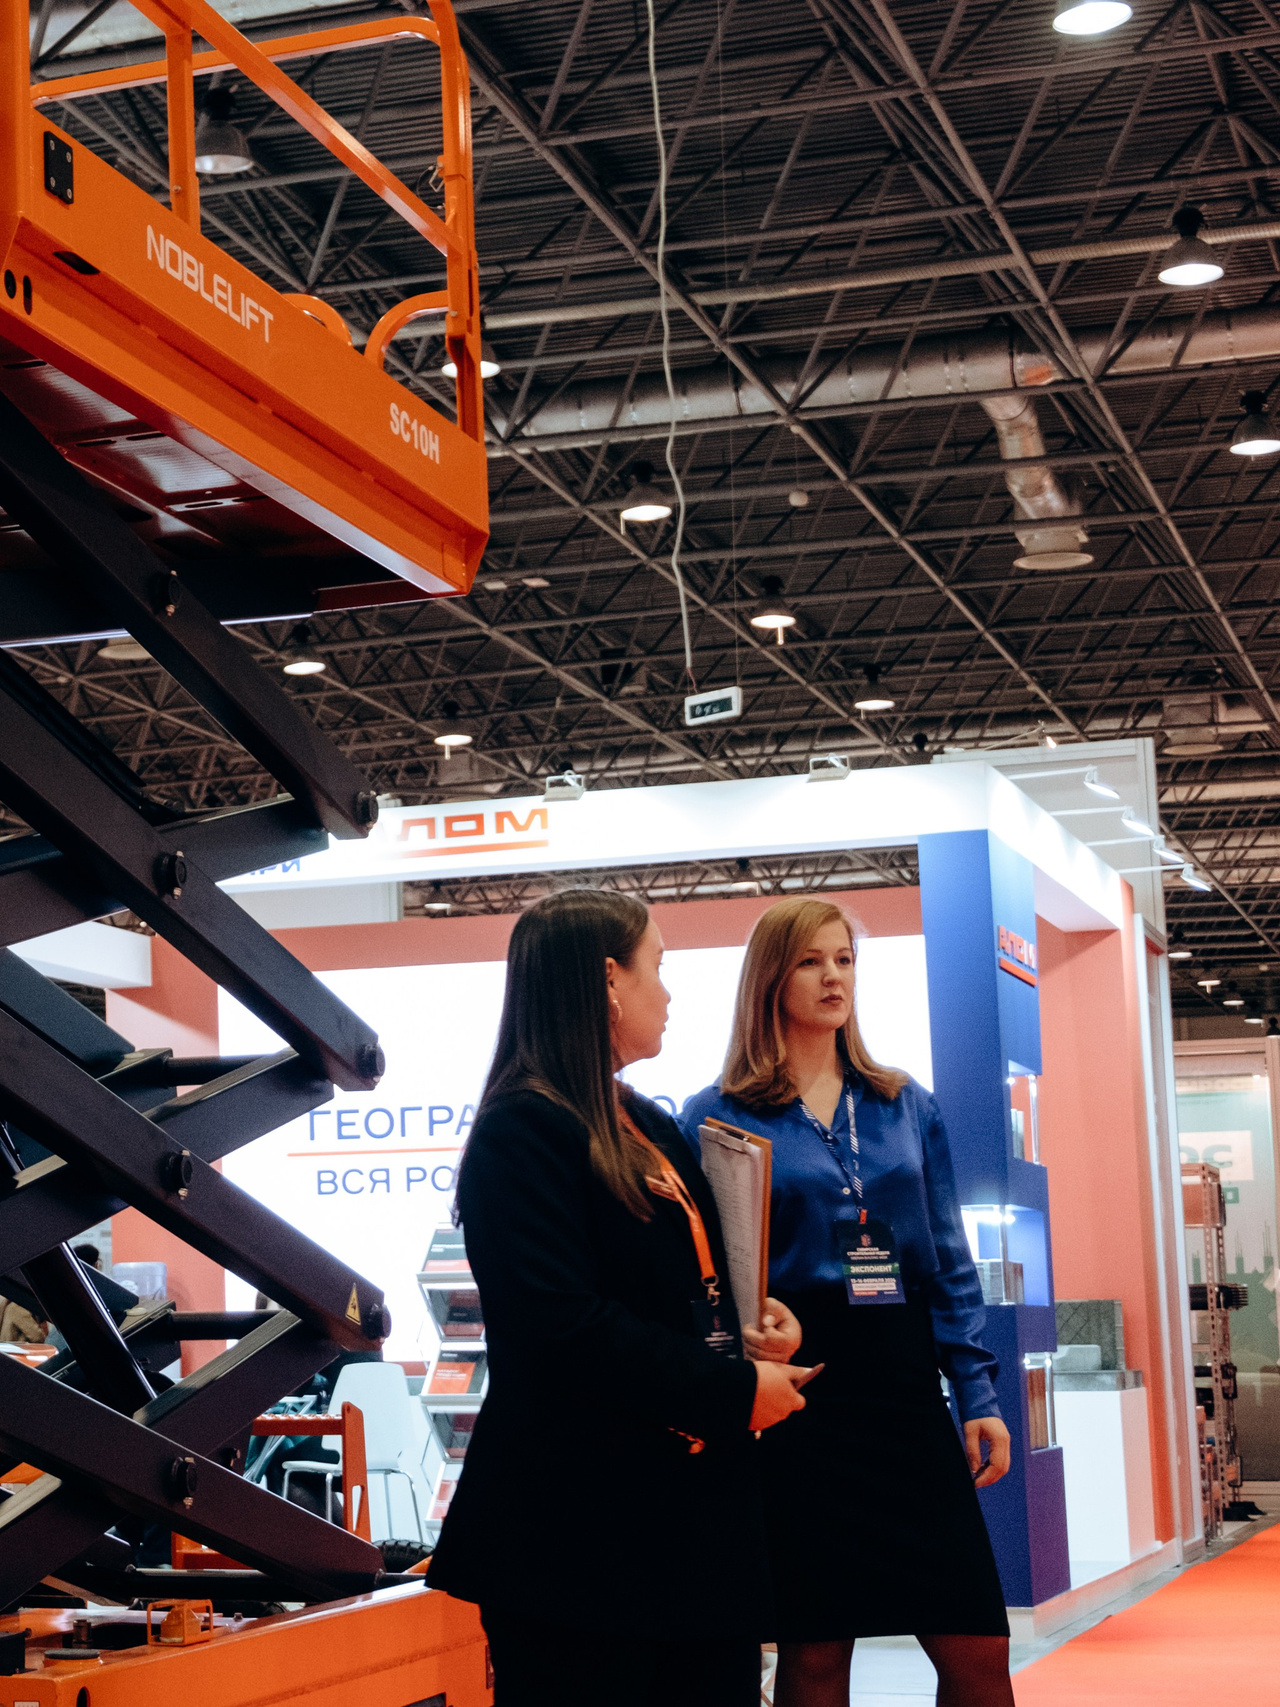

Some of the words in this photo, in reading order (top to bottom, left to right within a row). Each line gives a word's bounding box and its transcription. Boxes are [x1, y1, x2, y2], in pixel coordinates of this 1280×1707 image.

[147, 224, 274, 343] NOBLELIFT
[389, 402, 440, 465] SC10H
[396, 808, 548, 842] ЛОМ
[309, 1104, 476, 1141] ГЕОГРА
[317, 1168, 391, 1195] ВСЯ
[406, 1165, 457, 1192] РО
[850, 1265, 892, 1273] ЭКСПОНЕНТ
